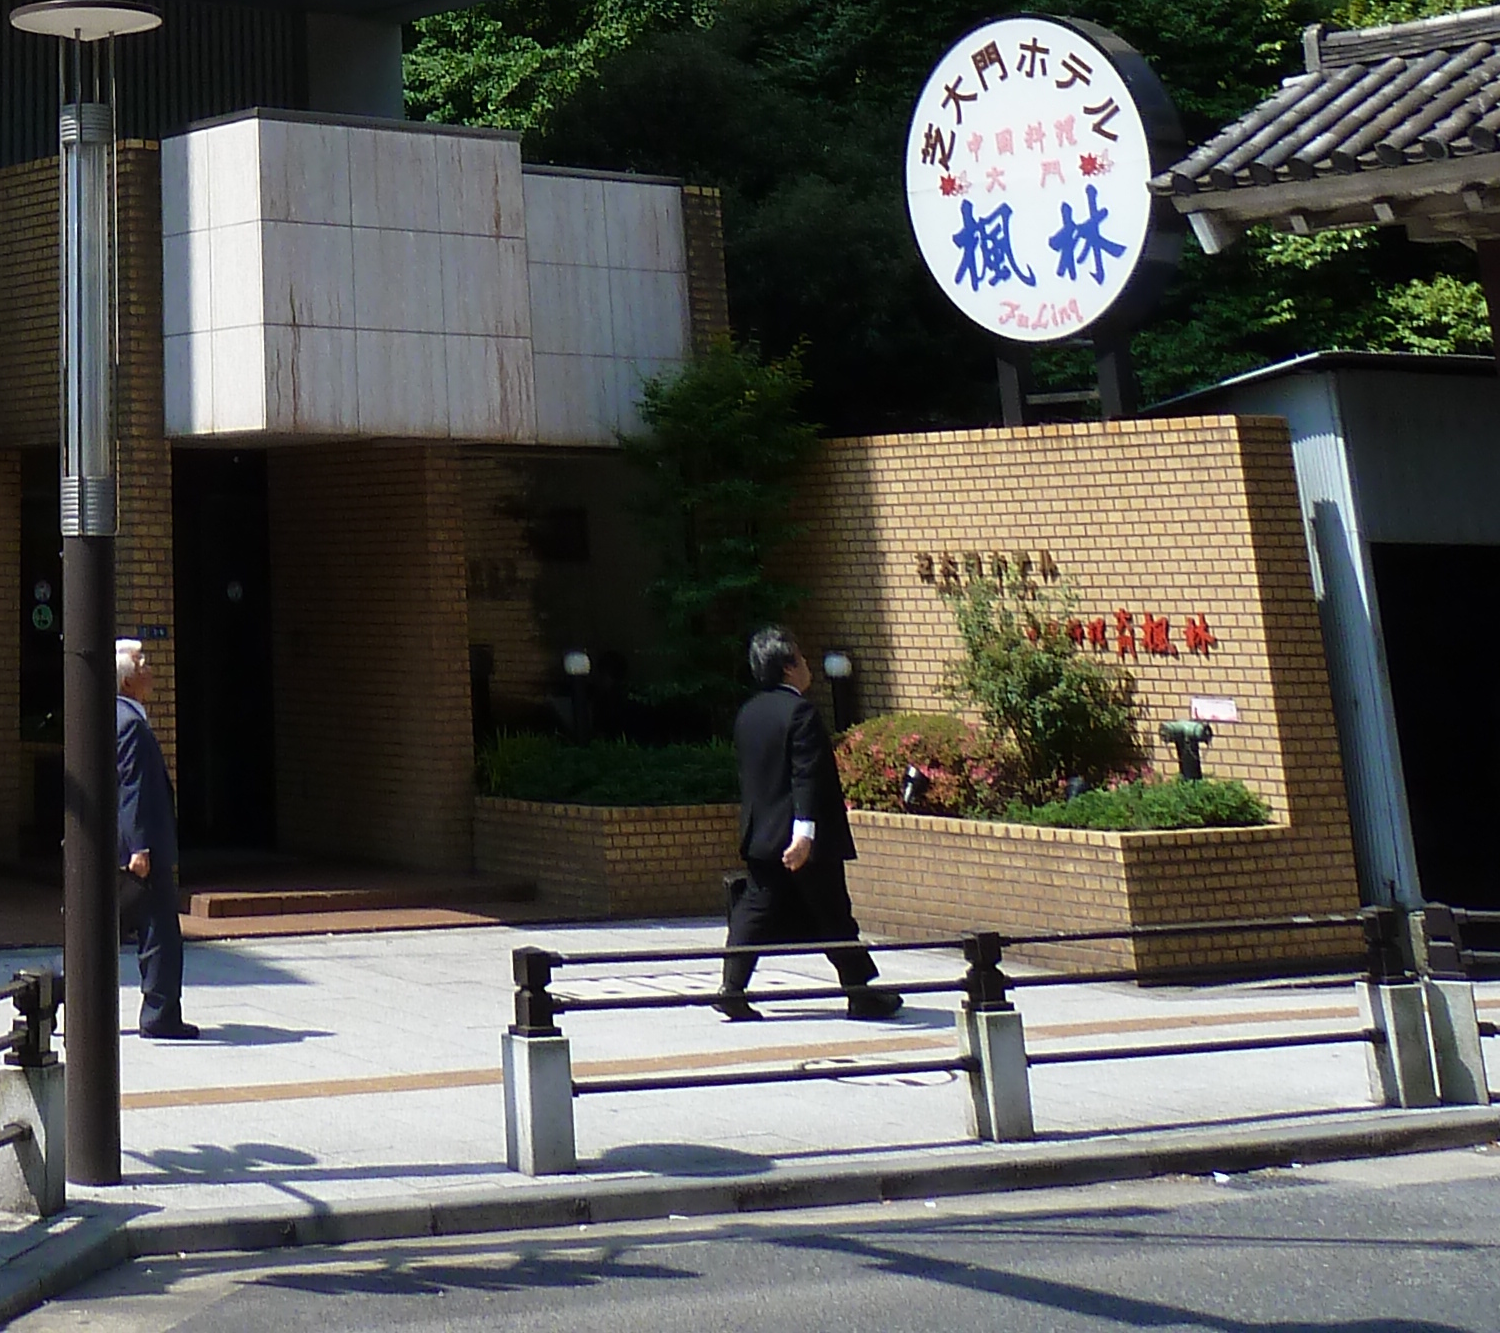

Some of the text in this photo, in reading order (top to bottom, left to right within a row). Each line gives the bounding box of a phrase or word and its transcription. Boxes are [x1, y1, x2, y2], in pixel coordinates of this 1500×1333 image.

[921, 37, 1120, 171] 芝大門ホテル
[986, 159, 1066, 192] 大門
[952, 184, 1127, 291] 楓林
